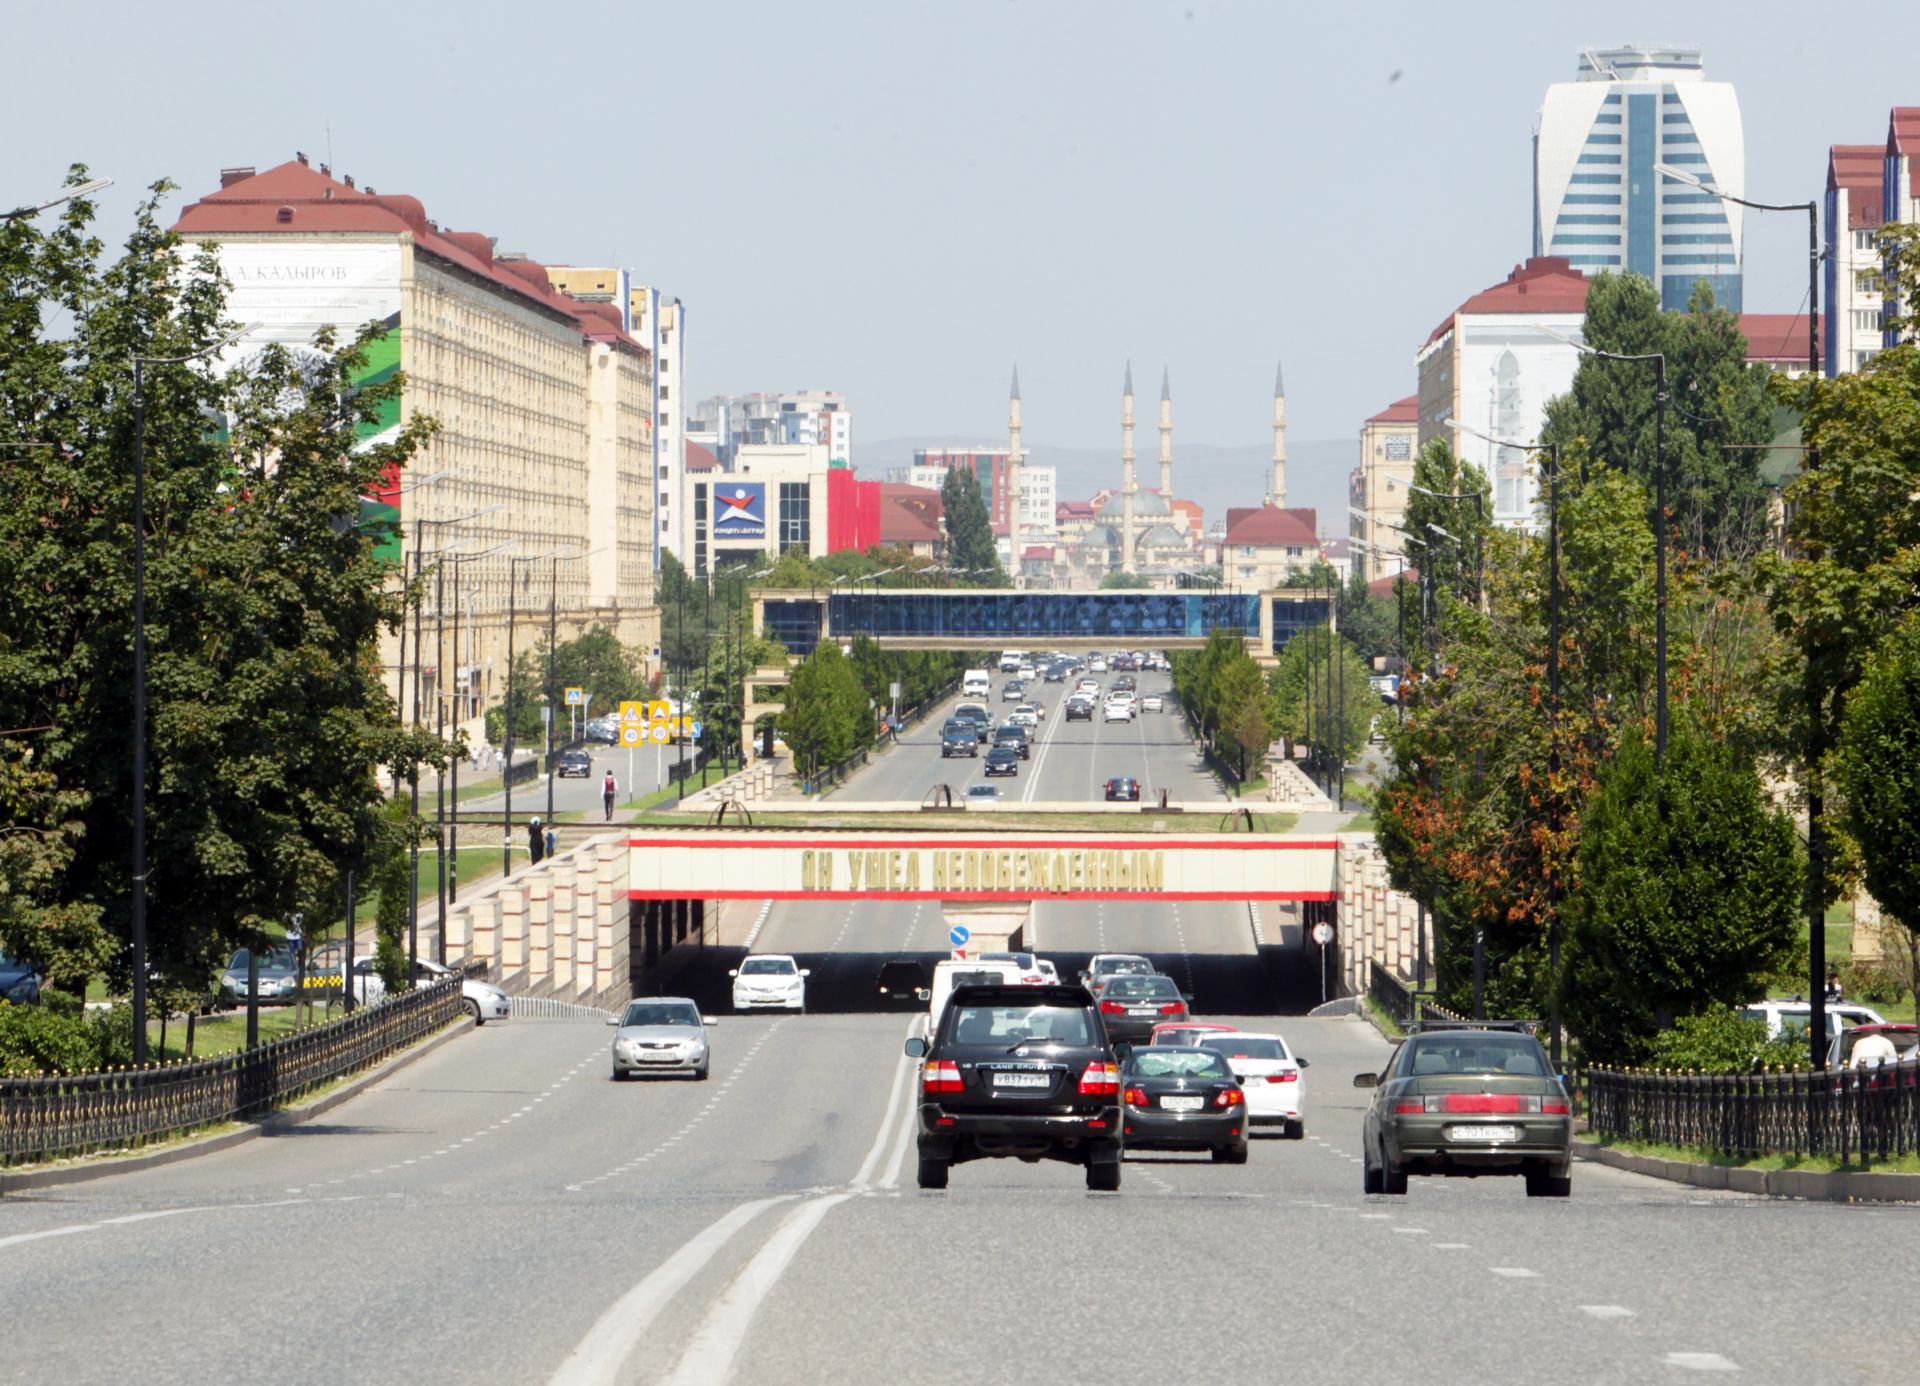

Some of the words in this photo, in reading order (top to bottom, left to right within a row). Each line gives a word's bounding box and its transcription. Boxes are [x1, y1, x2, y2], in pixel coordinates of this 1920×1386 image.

[257, 266, 347, 280] КАДЫРОВ
[801, 850, 833, 890] ОН
[848, 850, 920, 890] УШЕЛ
[932, 849, 1164, 894] НЕПОБЕЖДЕННЫМ
